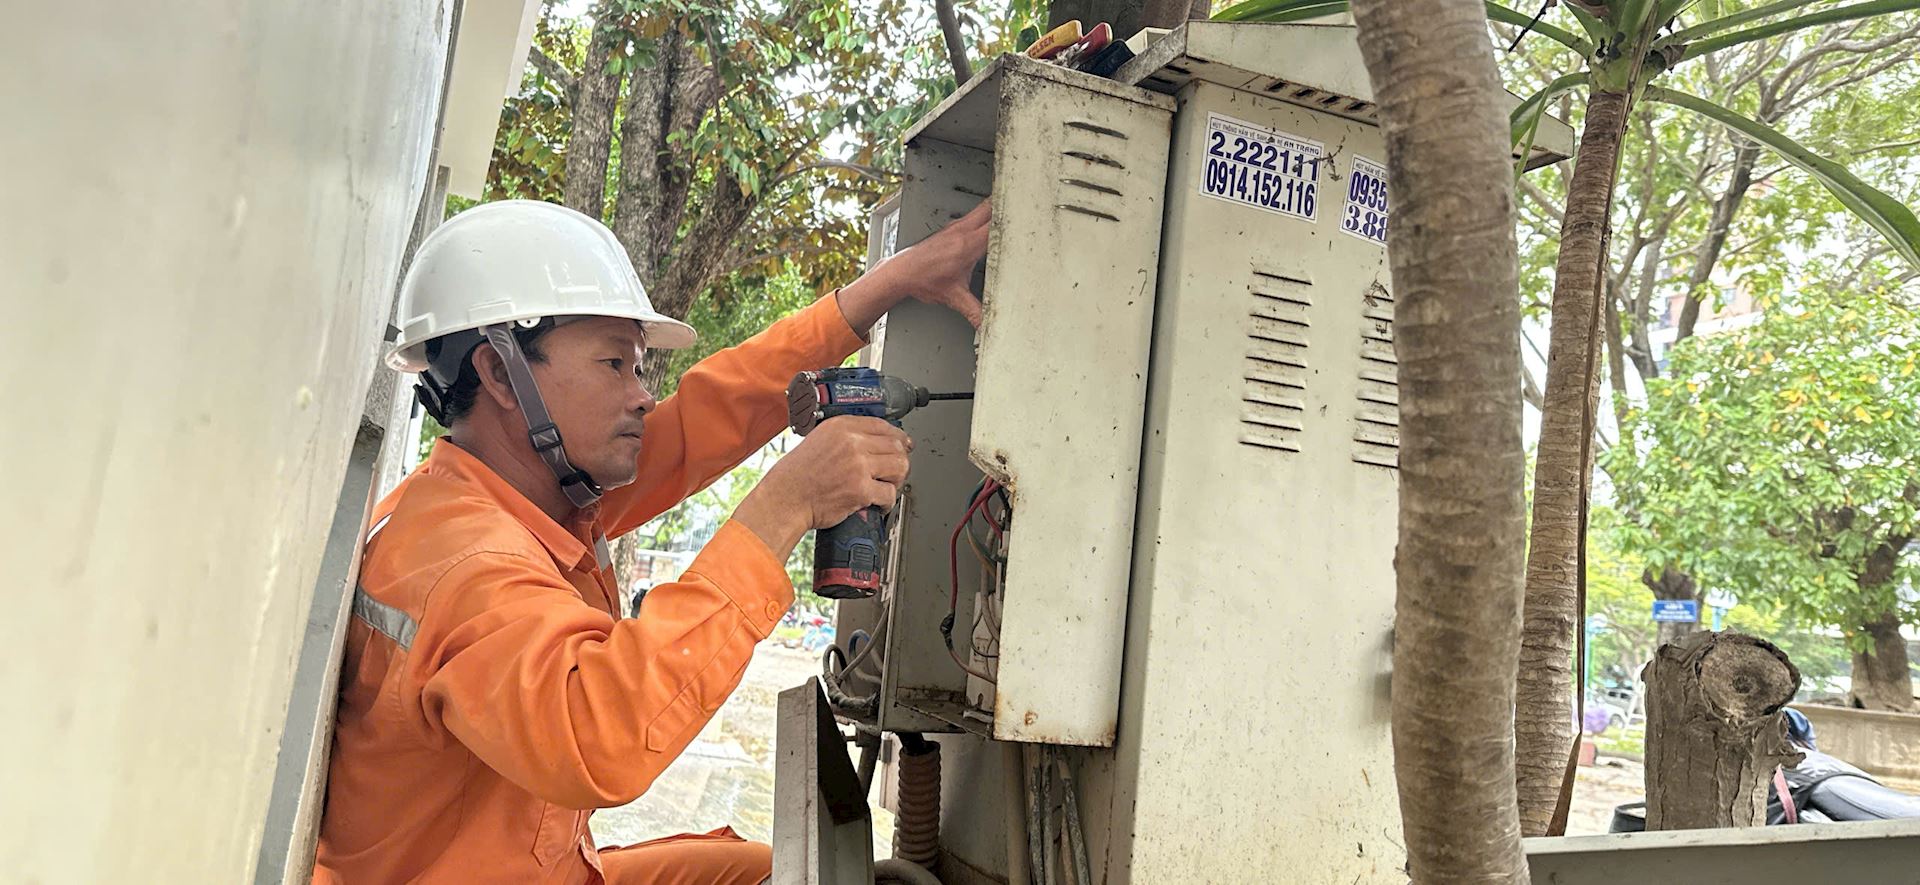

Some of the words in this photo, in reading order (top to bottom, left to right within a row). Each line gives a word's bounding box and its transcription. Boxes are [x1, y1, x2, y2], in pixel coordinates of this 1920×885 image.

[1209, 131, 1319, 181] 2.222111
[1283, 141, 1295, 149] AN
[1206, 158, 1316, 217] 0914.152.116
